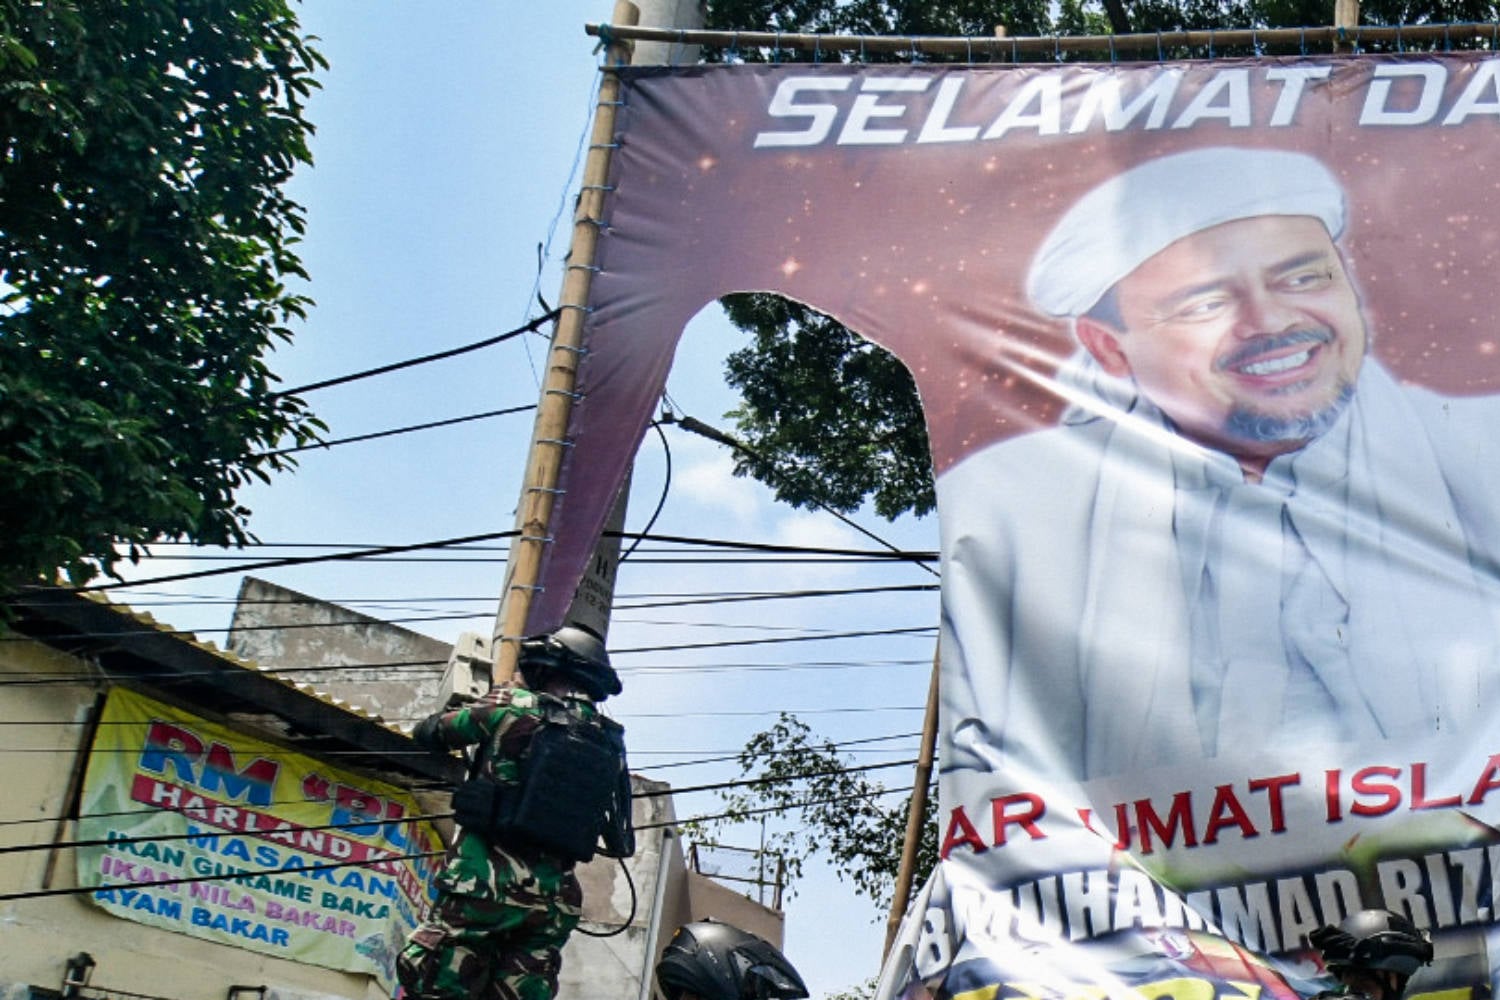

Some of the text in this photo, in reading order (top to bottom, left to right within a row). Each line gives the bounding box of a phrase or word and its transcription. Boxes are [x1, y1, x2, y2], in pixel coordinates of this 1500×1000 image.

[753, 65, 1332, 149] SELAMAT
[138, 717, 282, 808] RM
[152, 784, 353, 861] HARLAND
[101, 855, 179, 894] IKAN
[189, 881, 256, 915] NILA
[265, 902, 357, 940] BAKAR
[107, 830, 184, 868] IKAN
[194, 856, 314, 904] GURAME
[187, 825, 397, 900] MASAKAN
[96, 883, 290, 947] AYAM BAKAR
